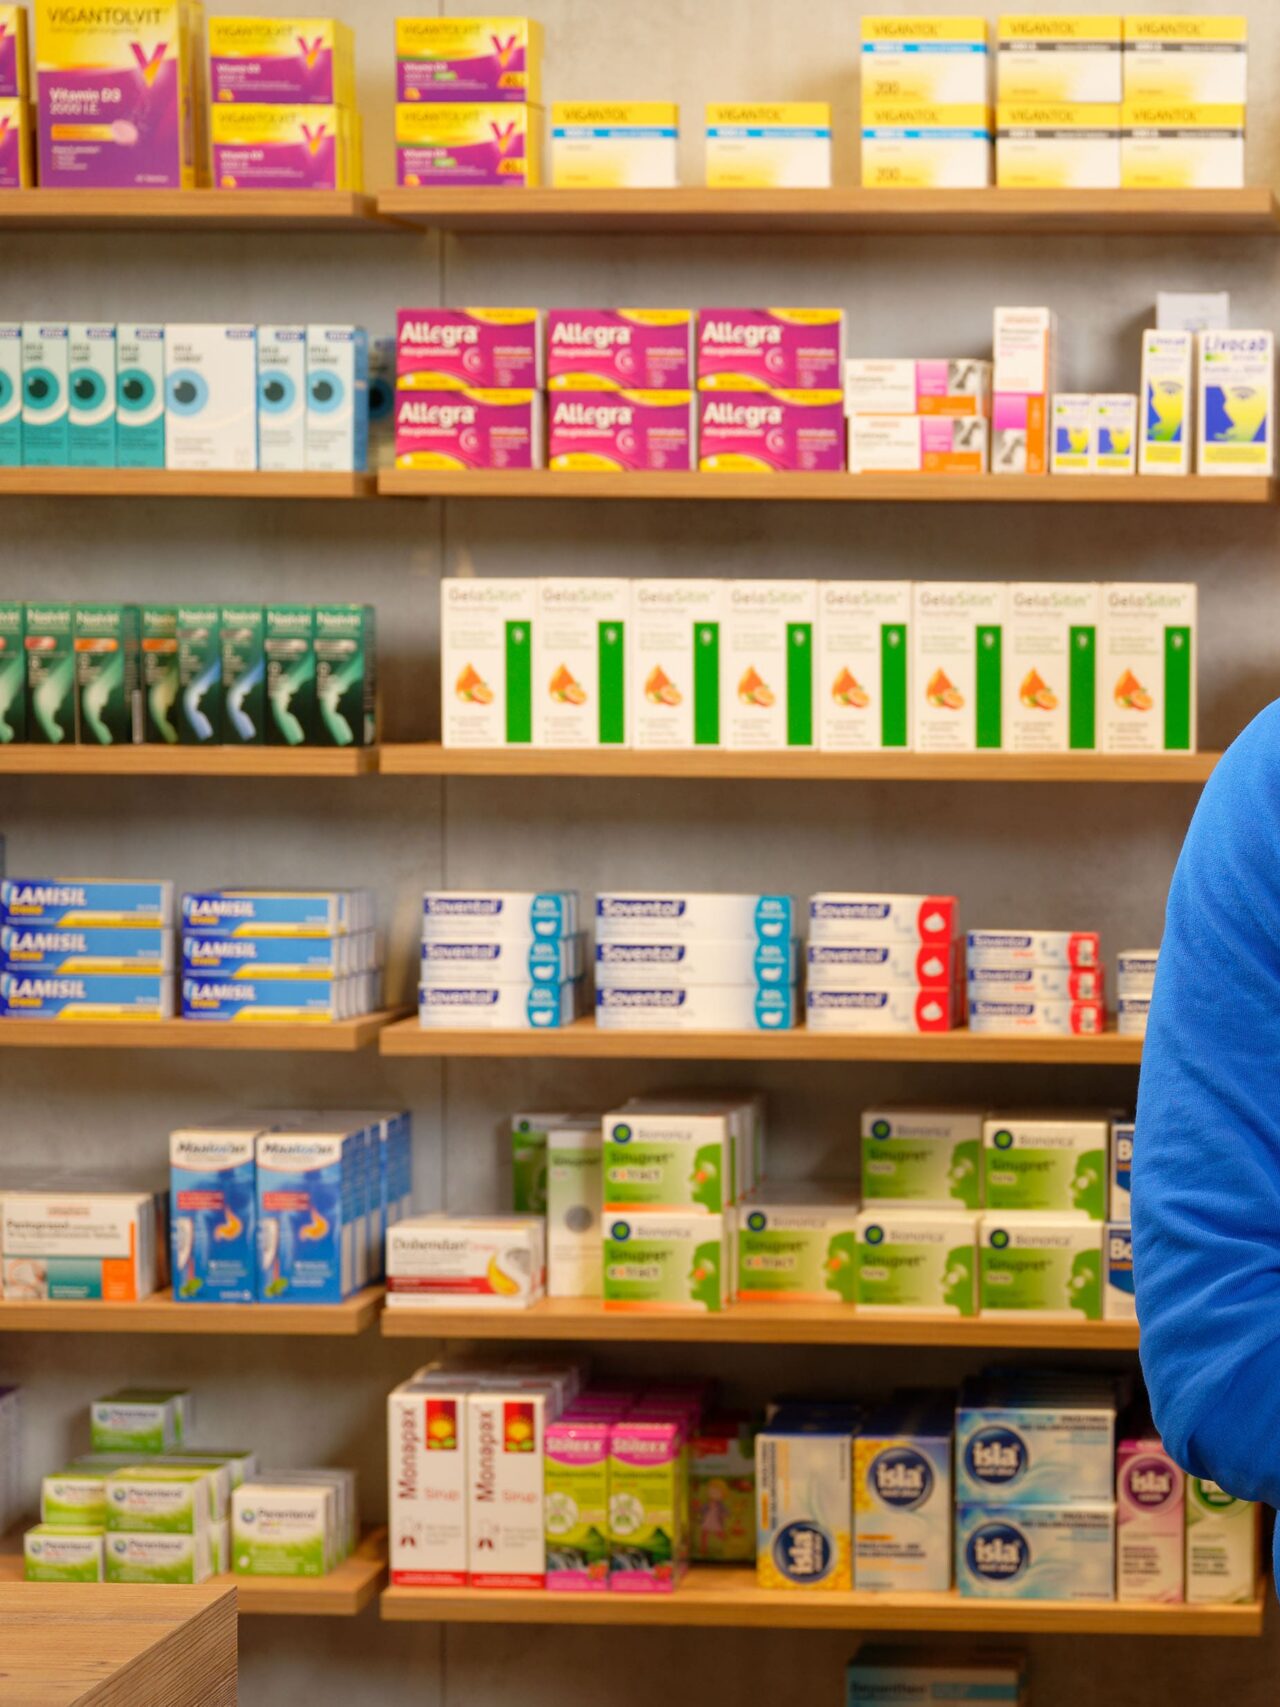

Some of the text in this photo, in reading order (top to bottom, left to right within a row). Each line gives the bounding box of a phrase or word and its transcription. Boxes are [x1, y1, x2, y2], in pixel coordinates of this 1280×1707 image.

[47, 7, 162, 26] VIGANTOLVIT
[400, 322, 478, 346] Allegra
[552, 322, 632, 346] Allegra
[703, 321, 782, 346] Allegra
[399, 402, 475, 428] Allegra
[554, 402, 632, 428] Allegra
[704, 402, 783, 428] Allegra
[9, 885, 86, 906] LAMISIL
[190, 901, 256, 918] LAMISIL
[10, 932, 87, 952] LAMISIL
[190, 942, 257, 958] LAMISIL
[9, 979, 86, 998] LAMISIL
[190, 985, 256, 1001] LAMISIL
[398, 1407, 421, 1501] Monapax
[475, 1408, 499, 1502] Monapax
[972, 1441, 1018, 1467] isla
[876, 1464, 923, 1489] isla
[974, 1538, 1020, 1564] isla
